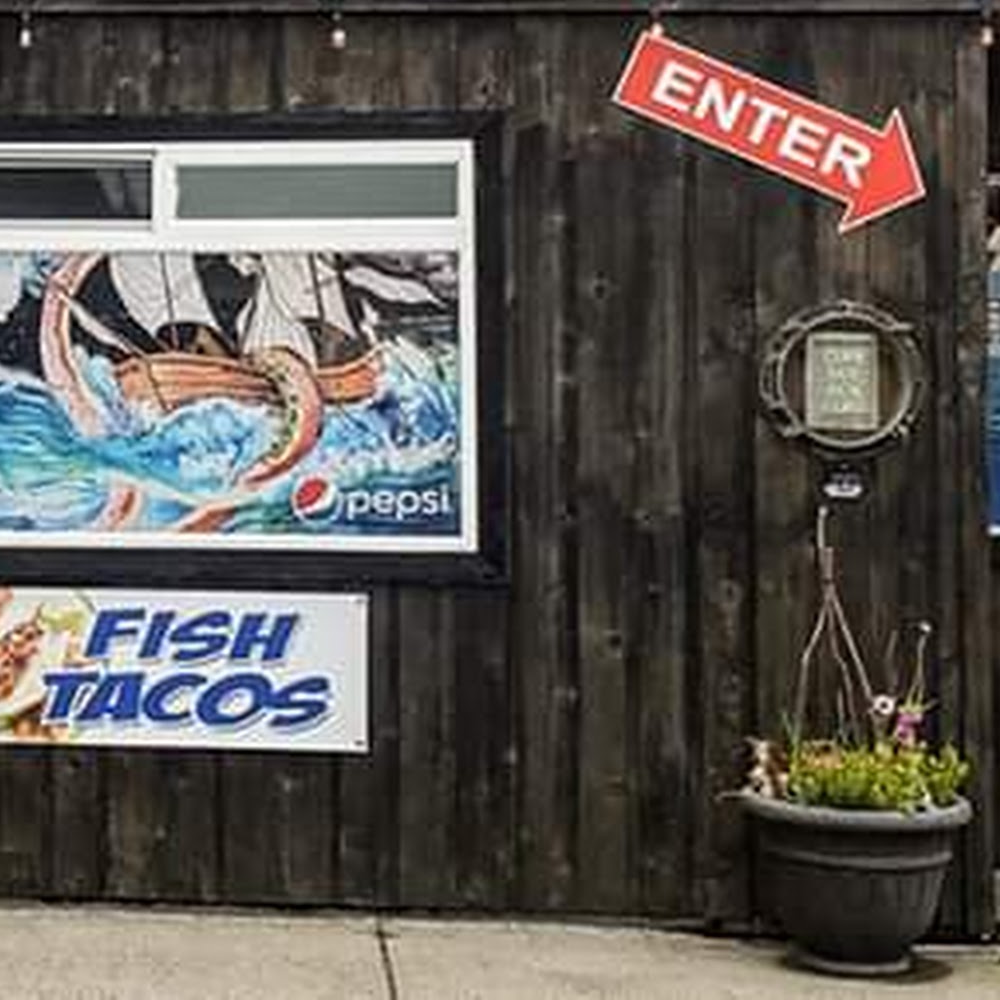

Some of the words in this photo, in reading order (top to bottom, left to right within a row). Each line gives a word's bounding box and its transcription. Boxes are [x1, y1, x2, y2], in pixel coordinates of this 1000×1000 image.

[650, 60, 873, 190] ENTER
[346, 484, 452, 521] pepsi
[84, 608, 300, 661] FISH
[42, 672, 331, 727] TACOS
